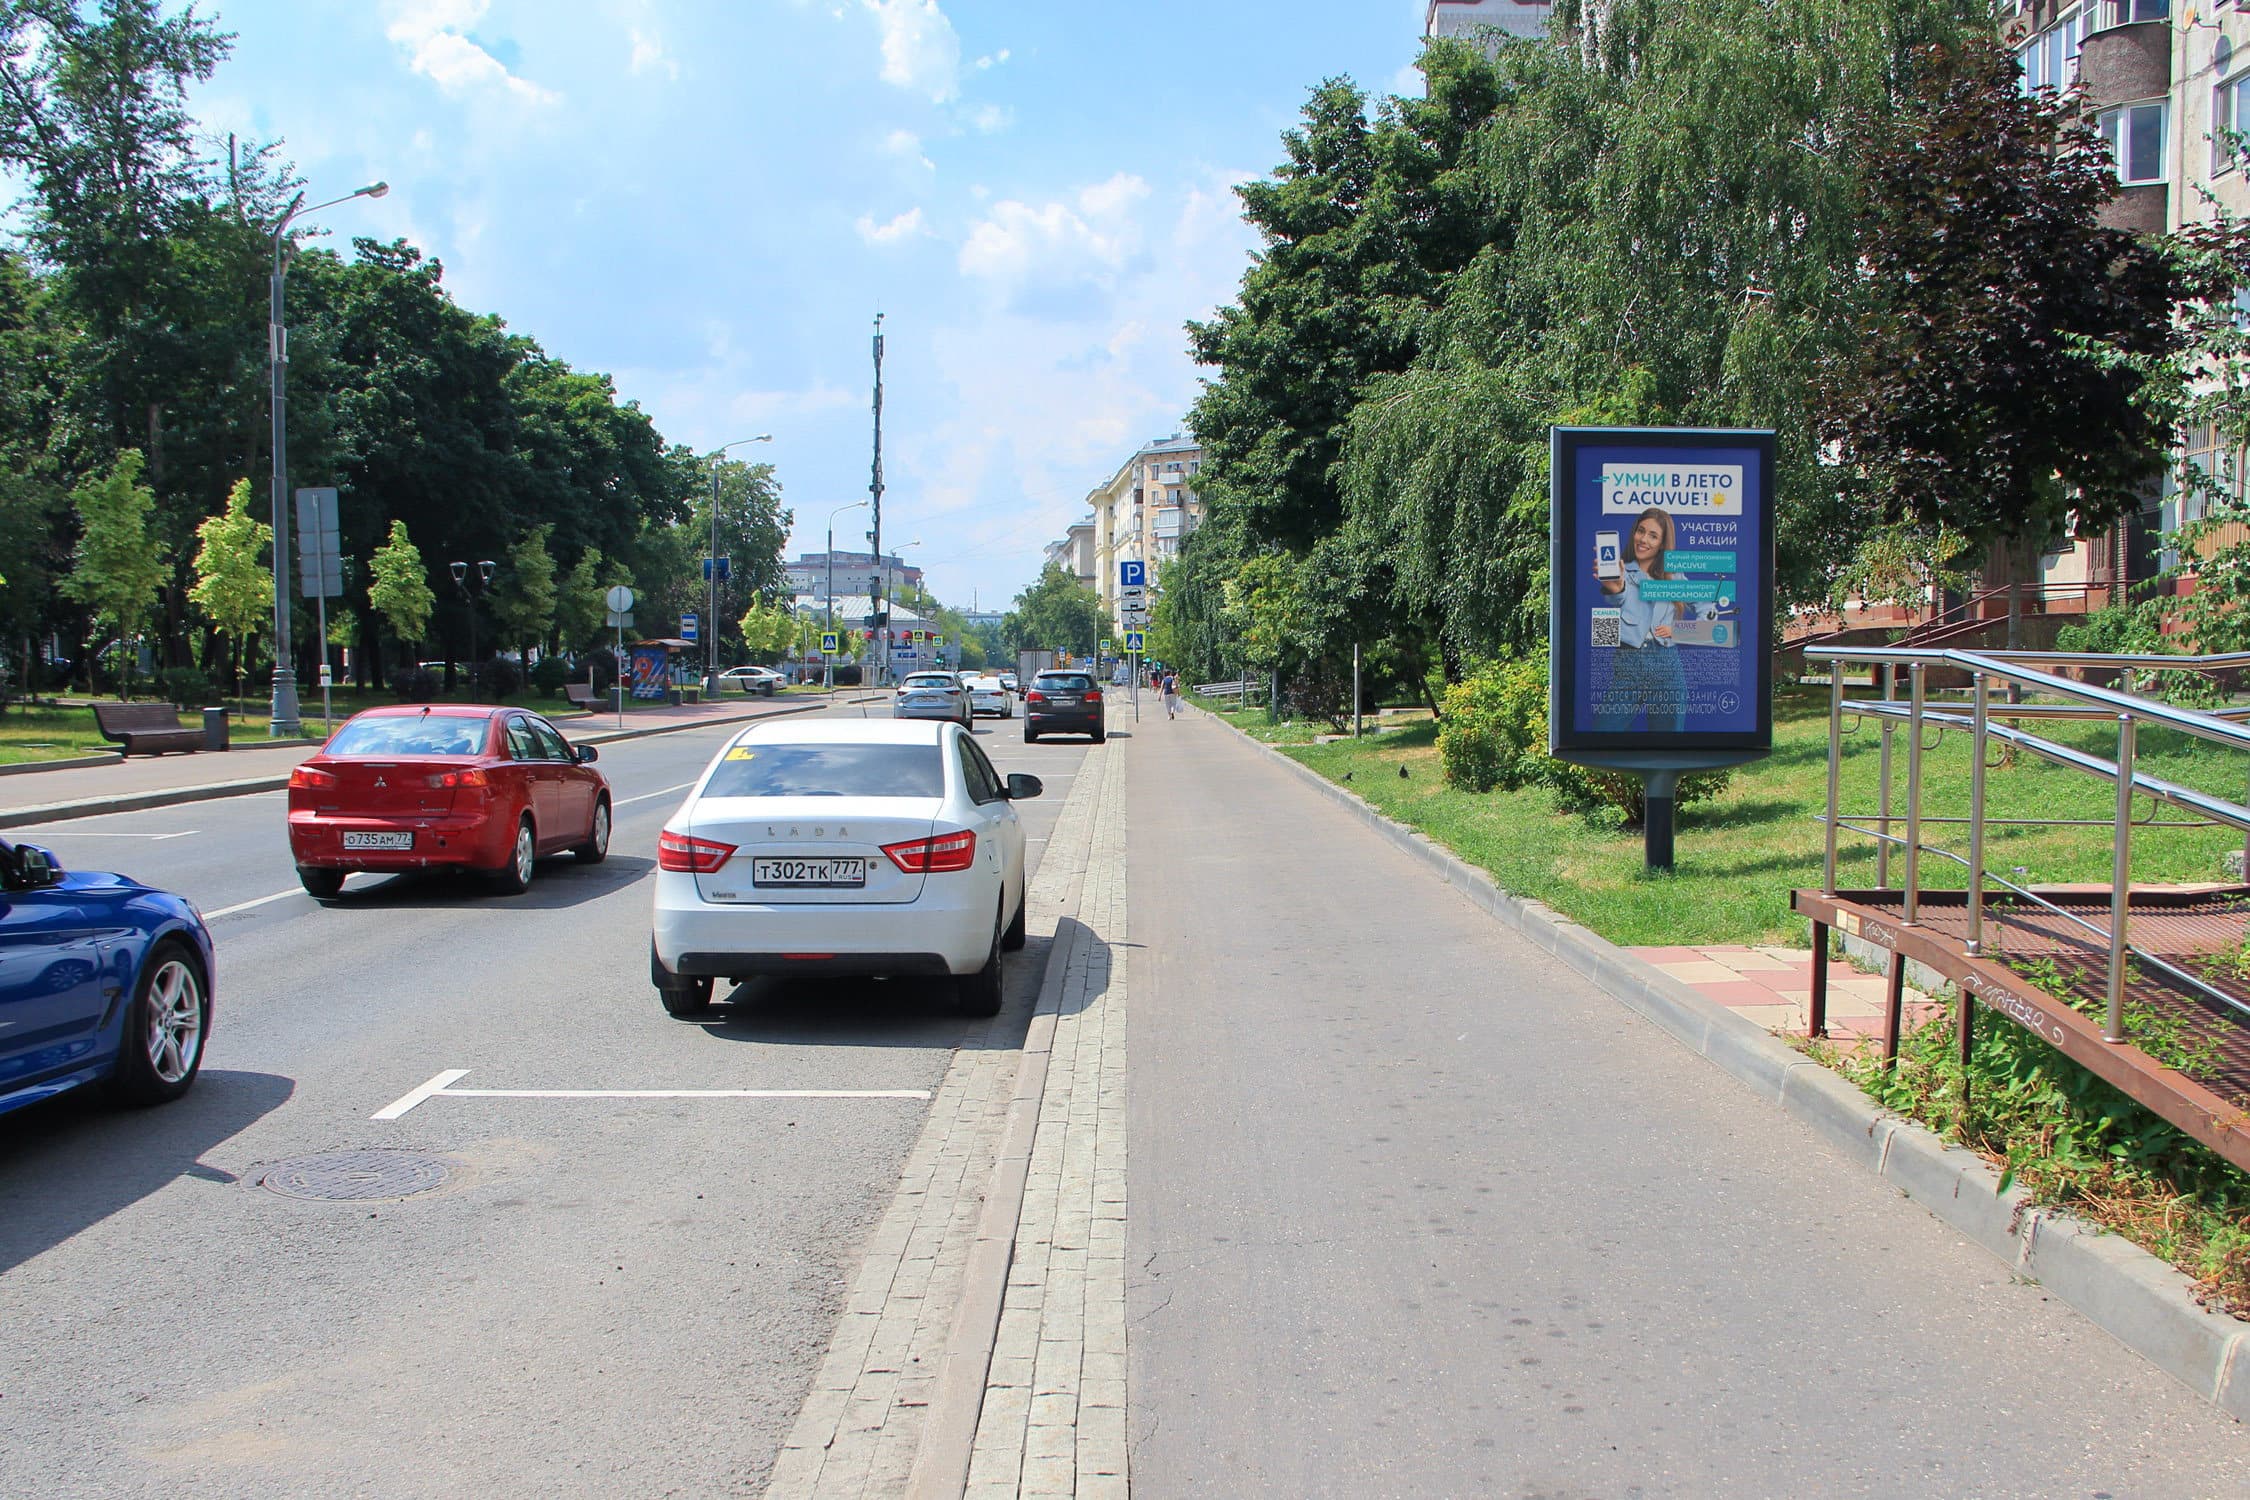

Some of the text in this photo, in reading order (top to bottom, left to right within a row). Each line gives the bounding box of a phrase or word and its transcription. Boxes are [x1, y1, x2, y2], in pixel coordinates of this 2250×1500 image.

[1613, 473, 1732, 488] УМЧИ В ЛЕТО
[1681, 521, 1737, 532] УЧАСТВУЙ
[1689, 536, 1737, 546] В АКЦИИ
[1127, 564, 1140, 584] P
[1721, 696, 1735, 709] 6+
[768, 826, 848, 837] LADA
[833, 861, 859, 874] 777
